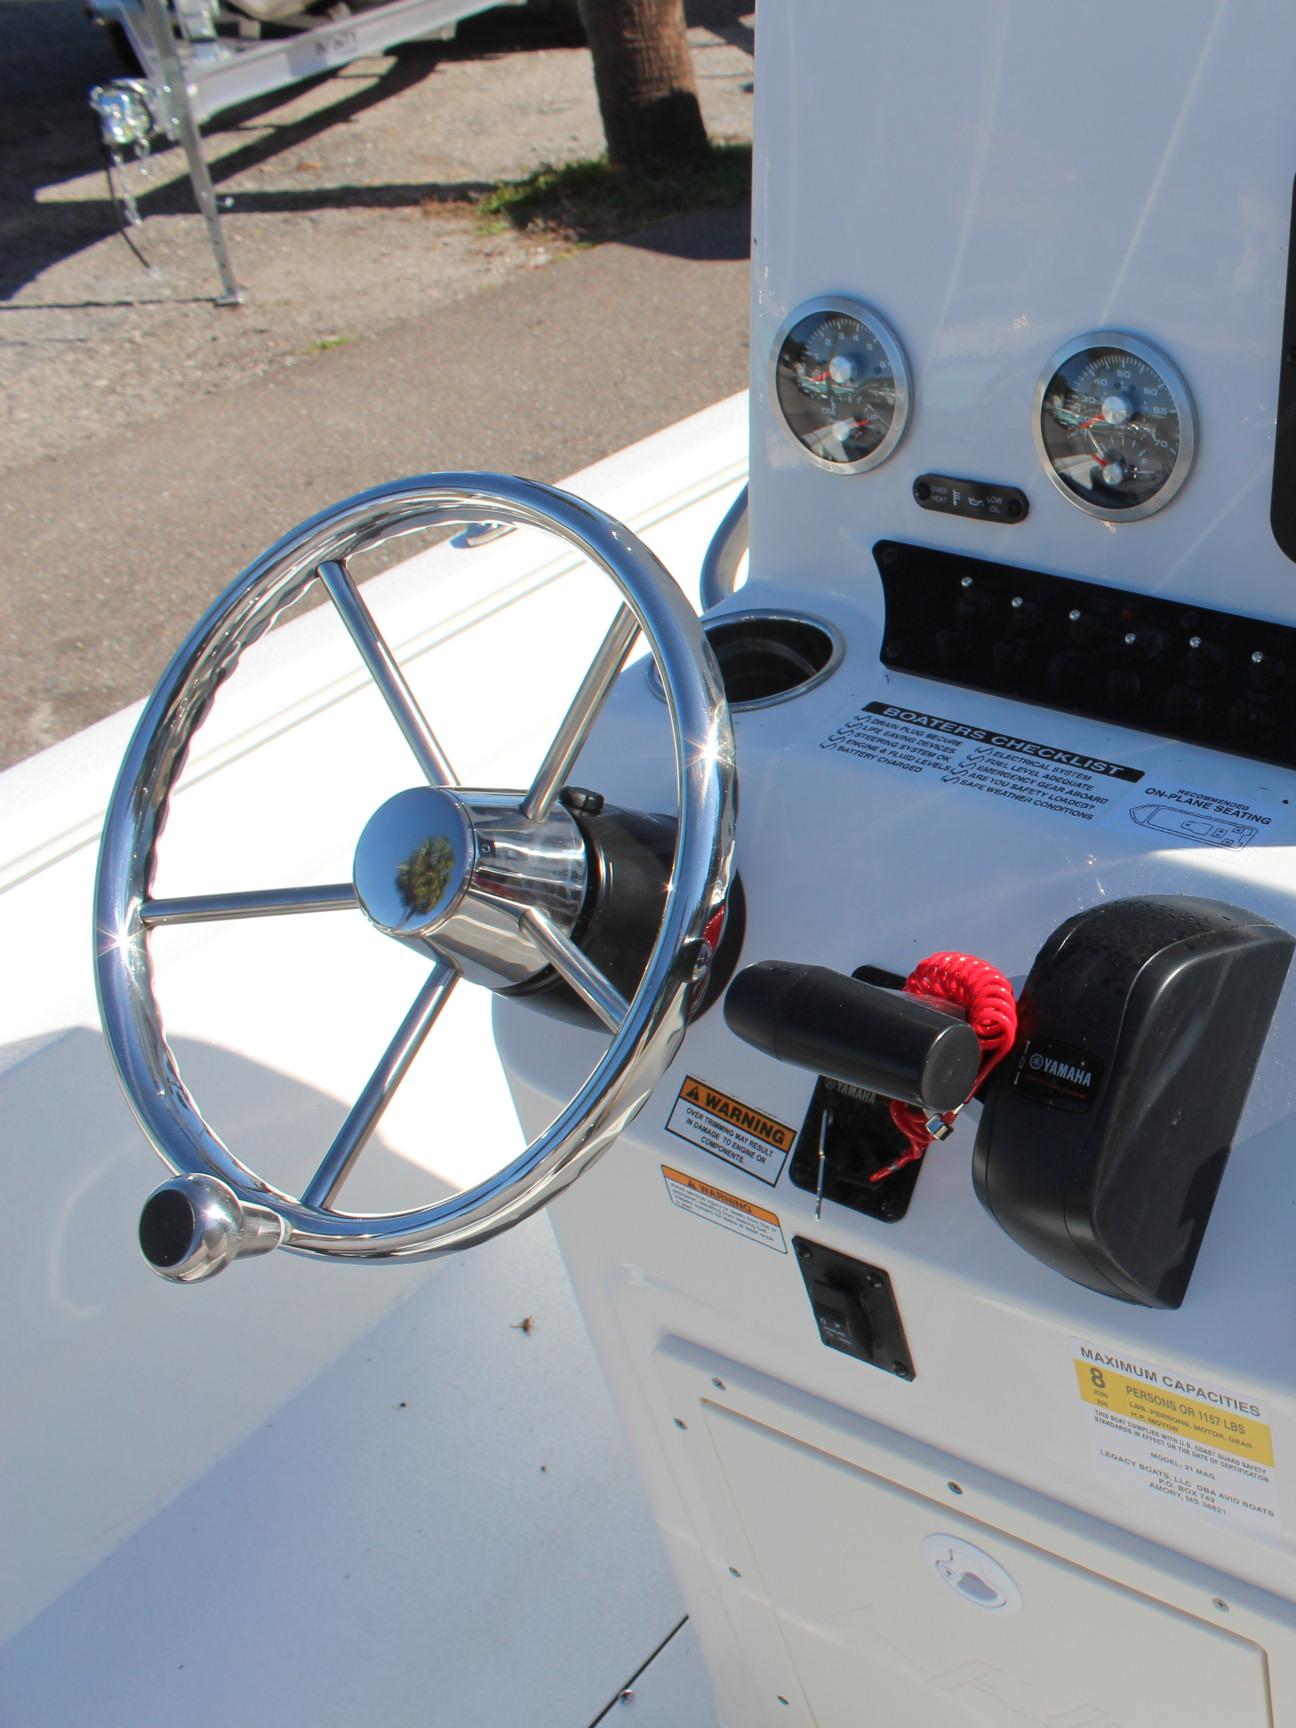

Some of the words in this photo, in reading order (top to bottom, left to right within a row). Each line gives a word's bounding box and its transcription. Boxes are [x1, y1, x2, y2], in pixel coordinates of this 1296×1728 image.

[1094, 379, 1108, 387] 40
[1117, 371, 1131, 379] 50
[1144, 387, 1158, 396] 60
[1153, 406, 1167, 415] 65
[1154, 439, 1168, 448] 70
[986, 495, 1003, 505] LOW
[862, 725, 883, 736] LIFE
[883, 730, 915, 744] SAVING
[917, 739, 958, 754] DEVICES
[870, 718, 900, 730] DRAIN
[901, 726, 924, 737] PLUG
[925, 731, 963, 747] SECURE
[882, 707, 988, 739] BOATERS
[992, 737, 1124, 777] CHECKLIST
[836, 745, 878, 760] BATTERY
[877, 757, 923, 773] CHARGED
[845, 739, 880, 752] ENGINE
[888, 750, 916, 761] FLUID
[915, 758, 952, 771] LEVELS
[853, 732, 899, 748] STEERING
[899, 743, 937, 758] SYSTEM
[937, 753, 952, 763] OK
[985, 757, 1009, 769] FUEL
[1011, 764, 1040, 778] LEVEL
[1042, 772, 1095, 792] ADEQUATE
[992, 751, 1049, 772] ELECTRICAL
[1052, 766, 1092, 782] SYSTEM
[968, 772, 988, 782] ARE
[990, 777, 1010, 788] YOU
[1009, 783, 1048, 798] SAFETY
[1049, 793, 1095, 811] LOADED?
[976, 765, 1038, 786] EMERGENCY
[1037, 781, 1066, 793] GEAR
[1064, 789, 1109, 805] ABOARD
[959, 779, 985, 791] SAFE
[986, 786, 1033, 804] WEATHER
[1033, 800, 1095, 821] CONDITIONS
[1144, 787, 1211, 810] ON-PLANE
[1213, 804, 1272, 825] SEATING
[1177, 789, 1250, 811] RECOMMENDED
[1043, 1057, 1093, 1088] YAMAHA
[836, 1081, 876, 1105] YAMAHA
[686, 1107, 704, 1121] OVER
[704, 1114, 735, 1137] TRIMMING
[734, 1131, 749, 1145] MAY
[749, 1138, 775, 1157] RESULT
[705, 1092, 785, 1145] WARNING
[686, 1117, 694, 1126] IN
[693, 1121, 721, 1140] DAMAGE
[723, 1136, 732, 1146] TO
[732, 1140, 756, 1160] ENGINE
[755, 1153, 767, 1165] OR
[701, 1136, 746, 1165] COMPONENTS.
[701, 1185, 753, 1213] WARNING
[1079, 1346, 1157, 1382] MAXIMUM
[1161, 1374, 1261, 1417] CAPACITIES
[1088, 1365, 1106, 1390] 8
[1125, 1384, 1176, 1411] PERSONS
[1178, 1404, 1195, 1418] OR
[1198, 1410, 1221, 1426] 1157
[1223, 1419, 1245, 1435] LBS
[1147, 1417, 1178, 1432] MOTOR
[1094, 1415, 1132, 1434] STANDARDS
[1132, 1429, 1140, 1437] IN
[1141, 1432, 1165, 1446] EFFECT
[1166, 1441, 1176, 1450] ON
[1177, 1445, 1189, 1455] THE
[1191, 1450, 1207, 1461] DATE
[1209, 1456, 1218, 1465] OF
[1094, 1409, 1108, 1419] THIS
[1109, 1414, 1126, 1425] BOAT
[1127, 1421, 1159, 1437] COMPLIES
[1160, 1433, 1177, 1444] WITH
[1194, 1445, 1215, 1457] COAST
[1217, 1453, 1241, 1466] GUARD
[1242, 1461, 1266, 1475] SAFETY
[1228, 1436, 1253, 1449] GEAR
[1099, 1448, 1136, 1467] LEGACY
[1195, 1483, 1217, 1497] DBA
[1218, 1491, 1239, 1505] AVID
[1241, 1499, 1274, 1517] BOATS
[1184, 1464, 1194, 1472] 21
[1195, 1468, 1215, 1480] MAG
[1148, 1480, 1183, 1500] AMORY,
[1185, 1494, 1199, 1505] MS
[1177, 1484, 1197, 1497] BOX
